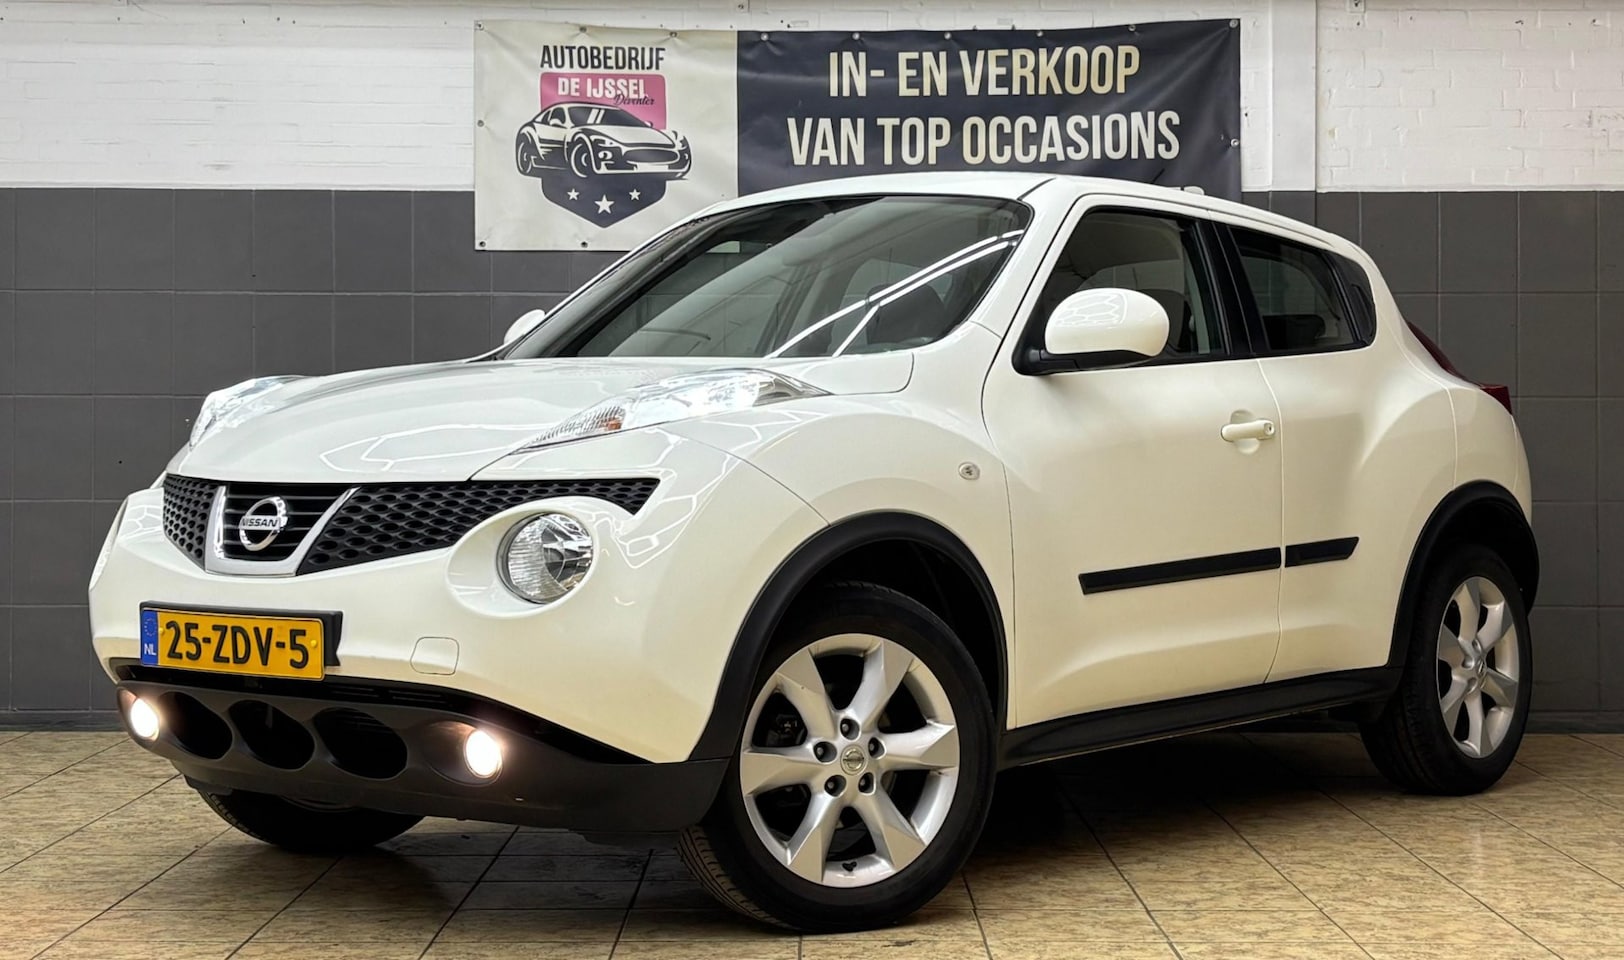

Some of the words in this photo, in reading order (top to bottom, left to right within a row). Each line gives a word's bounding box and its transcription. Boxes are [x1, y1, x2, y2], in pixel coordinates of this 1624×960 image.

[540, 45, 665, 70] AUTOBEDRIJF
[828, 52, 885, 97] IN-
[898, 51, 947, 96] EN
[960, 45, 1140, 96] VERKOOP
[557, 77, 580, 96] DE
[586, 78, 647, 99] IJSSEL
[612, 94, 656, 107] Deventer
[787, 117, 865, 166] VAN
[877, 117, 951, 166] TOP
[962, 110, 1181, 166] OCCASIONS
[144, 643, 157, 656] NL
[165, 620, 310, 669] 25-ZDV-5
